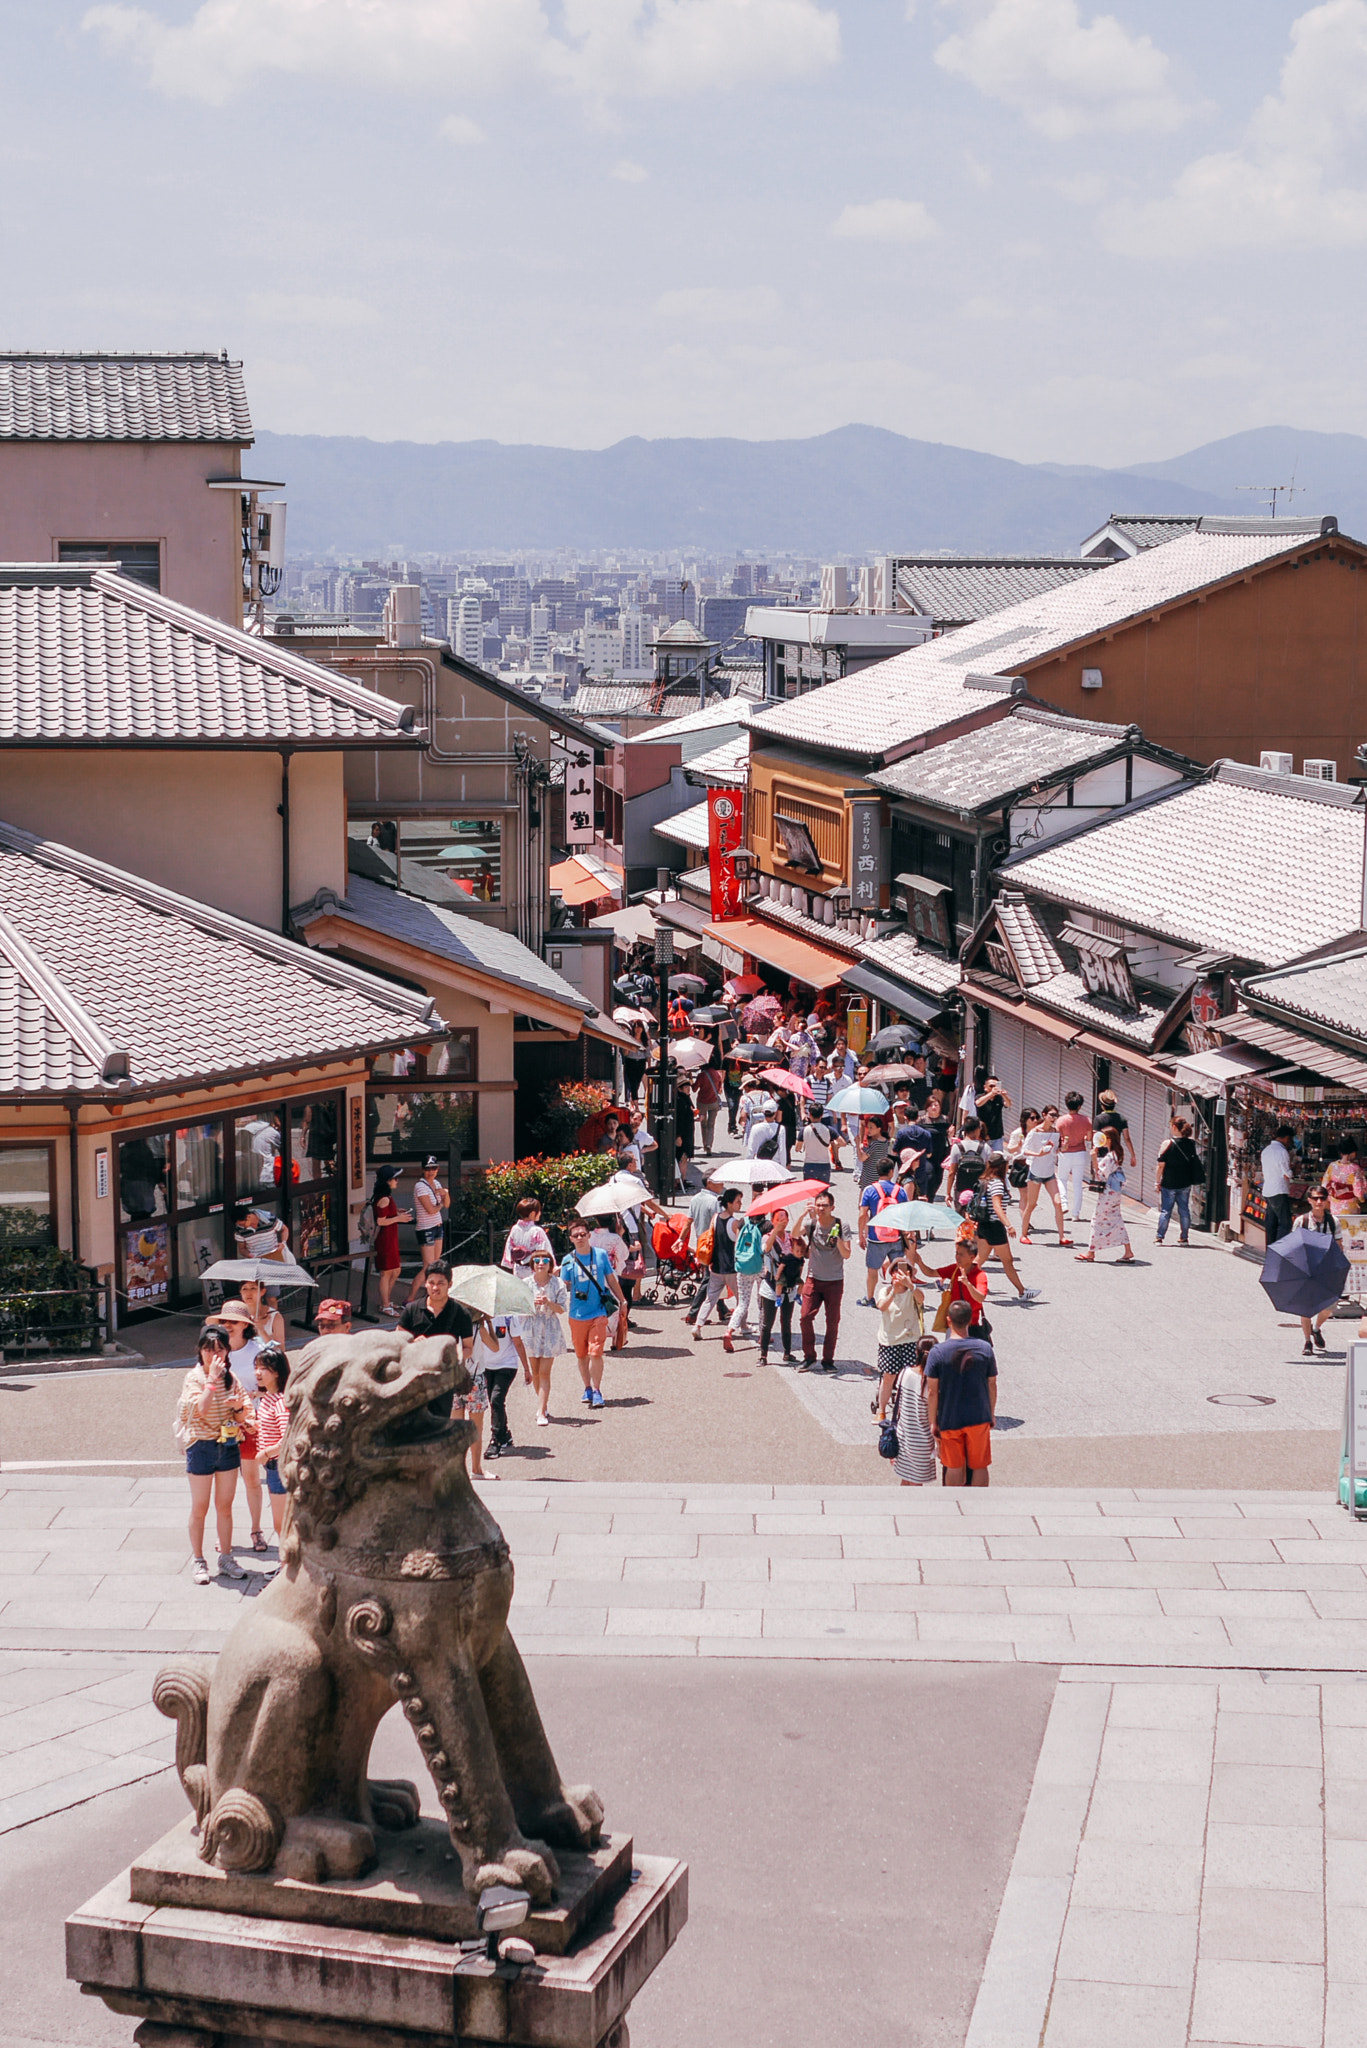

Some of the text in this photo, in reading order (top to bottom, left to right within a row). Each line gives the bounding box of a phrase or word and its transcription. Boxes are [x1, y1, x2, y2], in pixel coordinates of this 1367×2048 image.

[862, 811, 871, 850] 京つけもの
[857, 854, 875, 899] 西利
[128, 1281, 168, 1299] 平和の響き
[200, 1245, 220, 1293] 立入止
